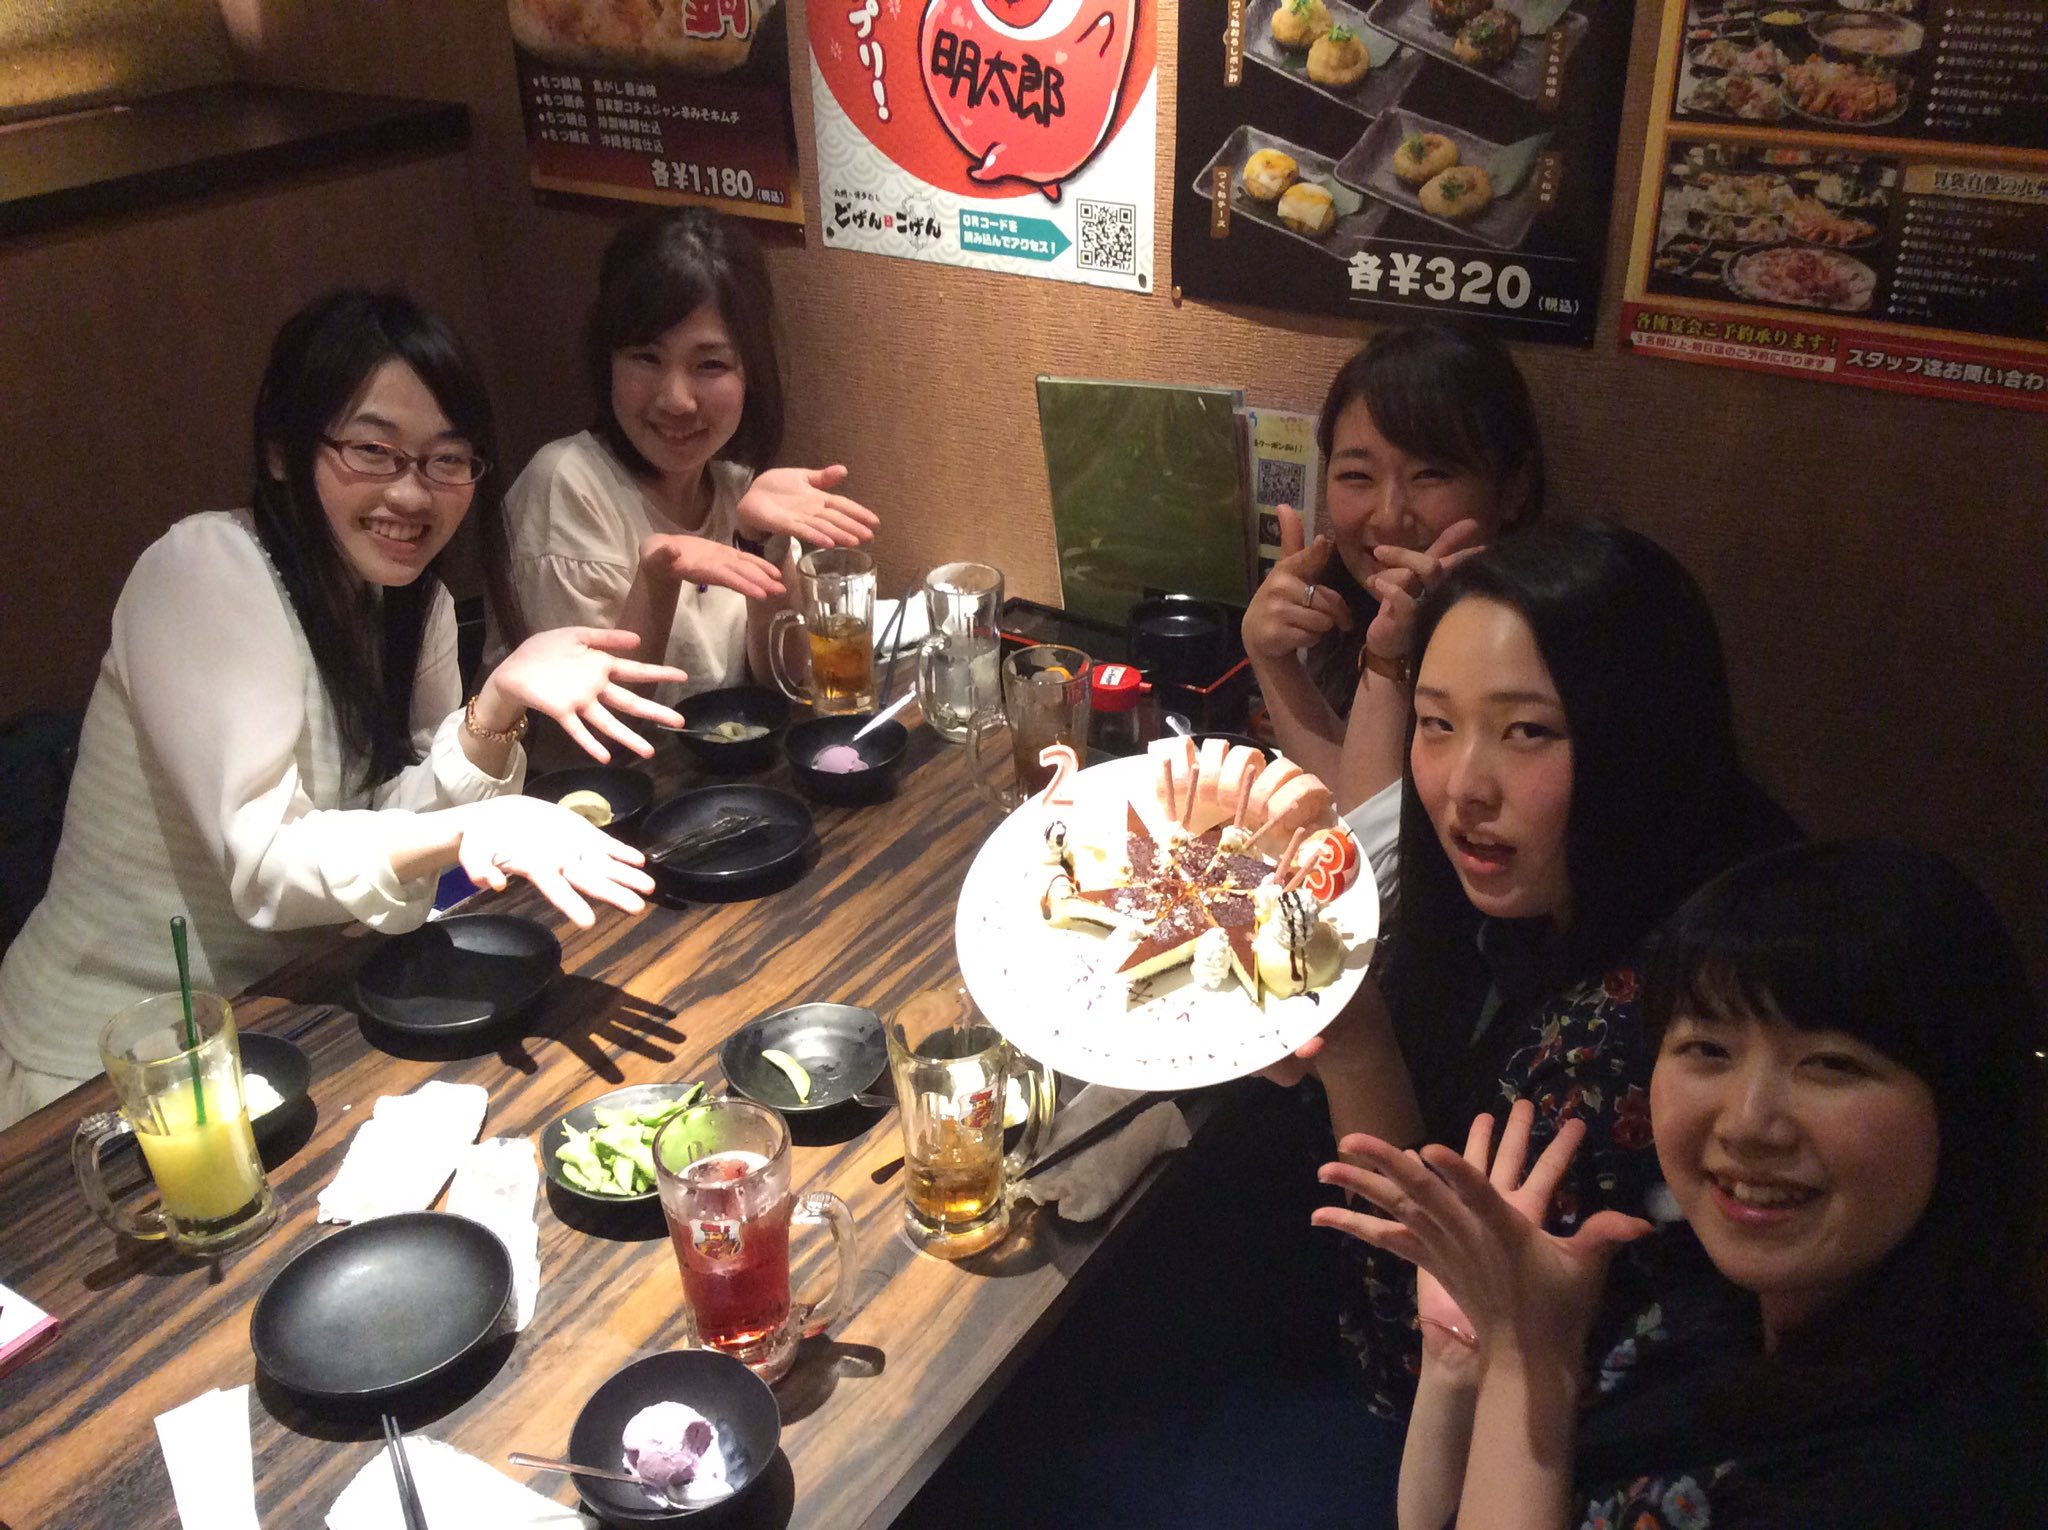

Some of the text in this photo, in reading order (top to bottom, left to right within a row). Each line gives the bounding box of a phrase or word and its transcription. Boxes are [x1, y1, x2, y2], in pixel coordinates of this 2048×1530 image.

[931, 29, 1065, 127] 明太郎
[1347, 251, 1531, 310] 各¥320
[1845, 348, 2048, 392] スタッフ迄お問い合わ
